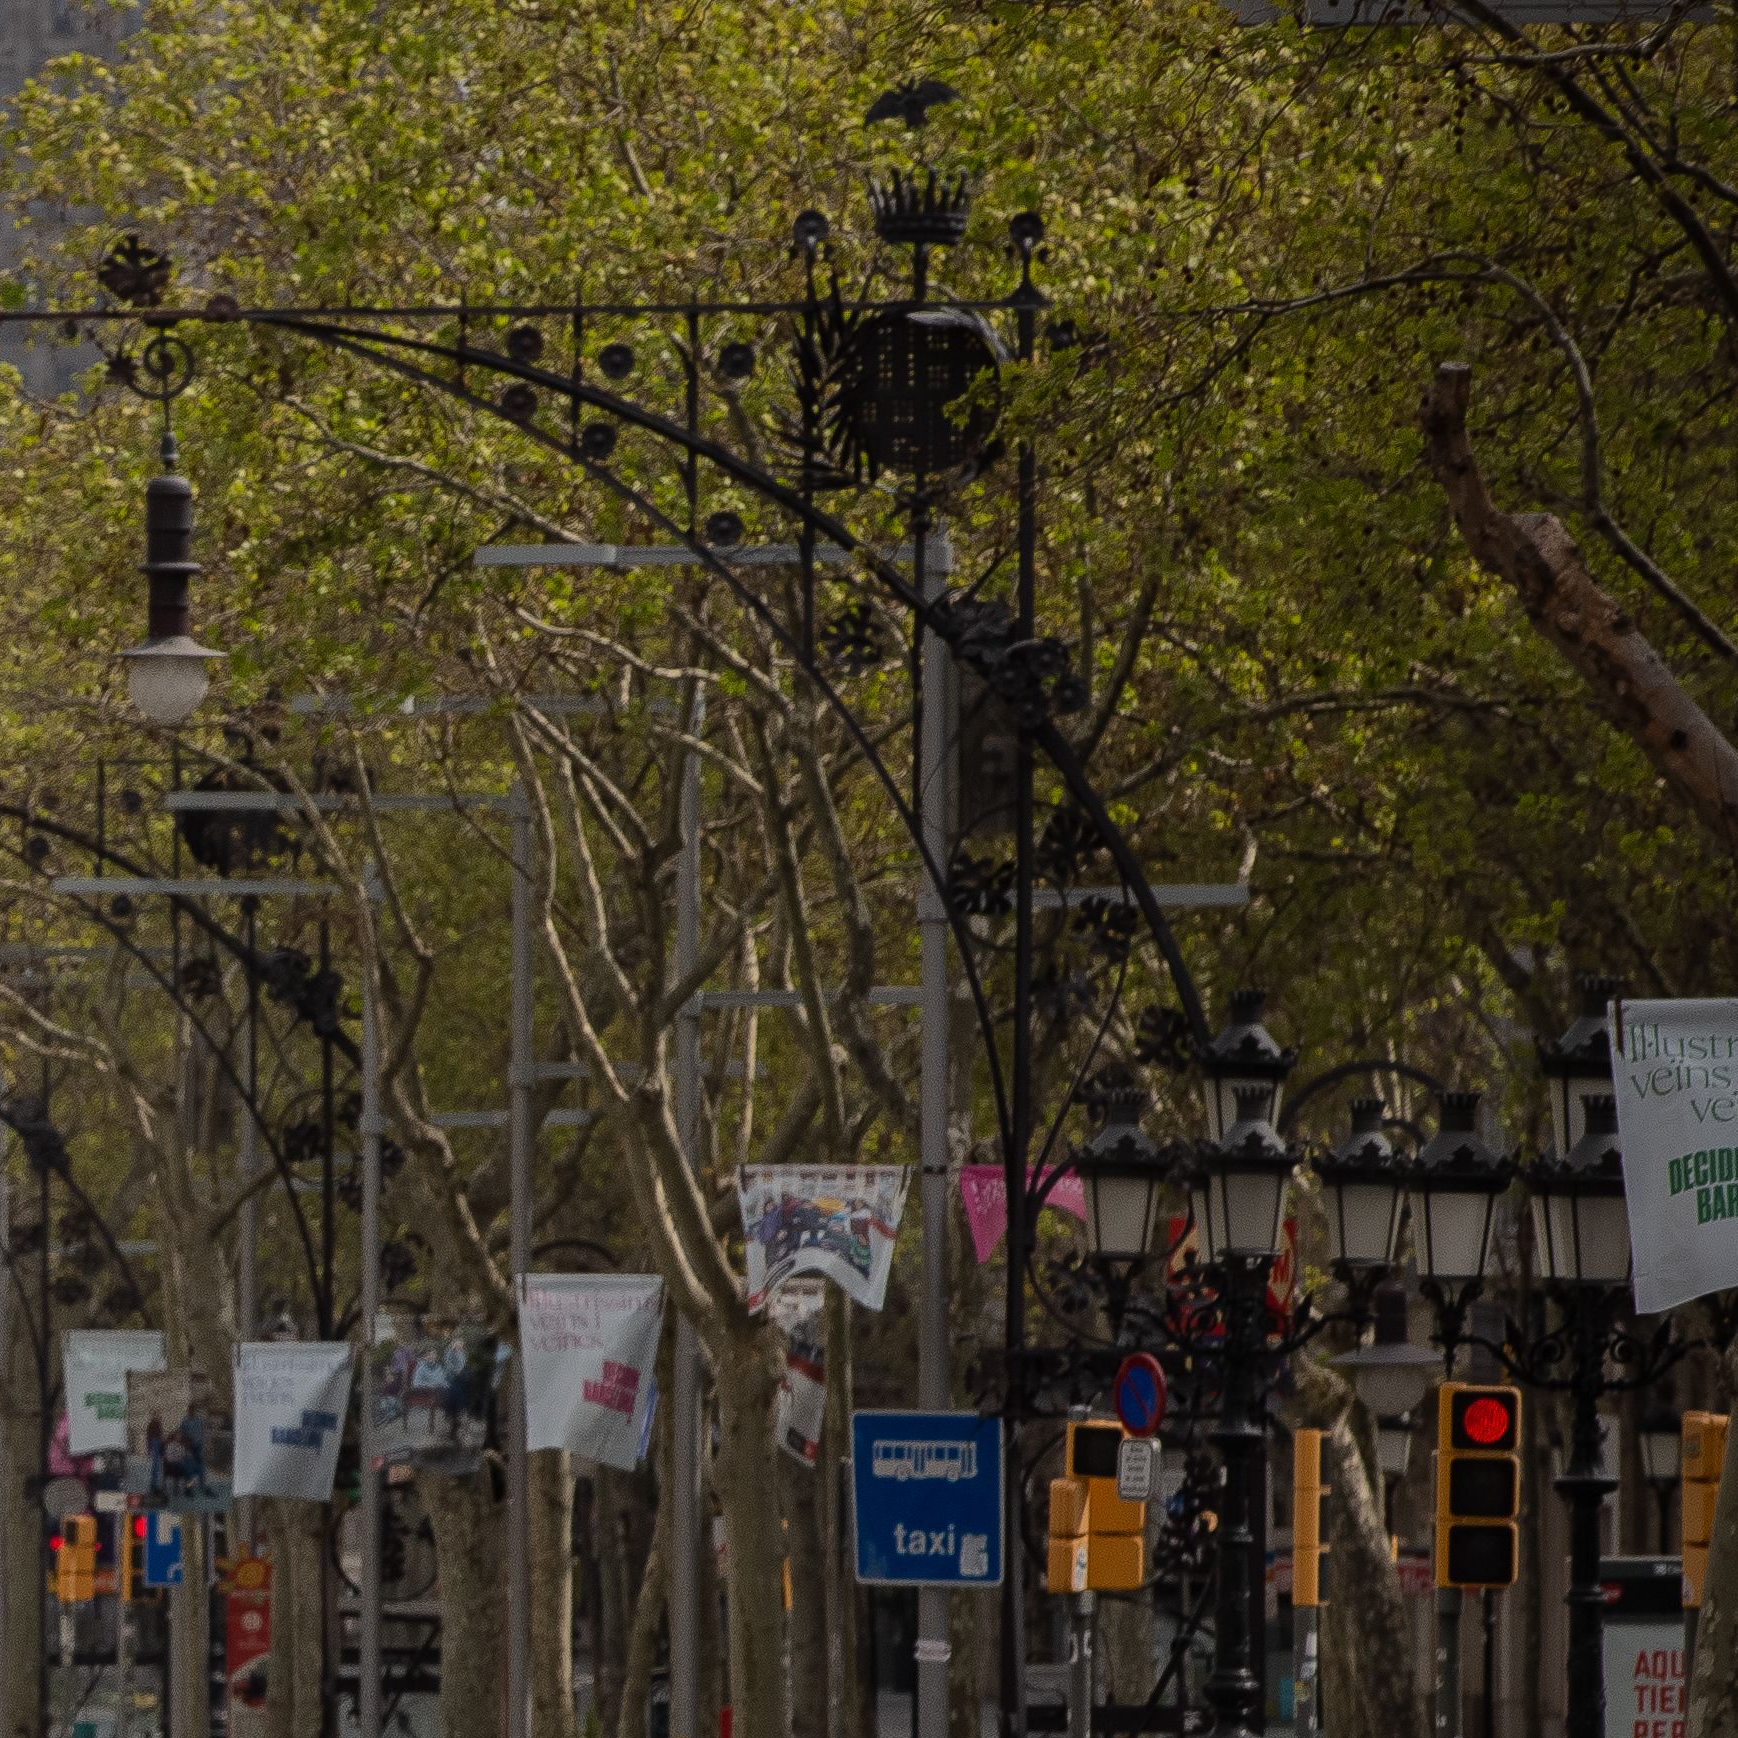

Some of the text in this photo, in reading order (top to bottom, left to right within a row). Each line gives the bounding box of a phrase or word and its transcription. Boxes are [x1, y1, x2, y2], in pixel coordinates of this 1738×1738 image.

[1630, 1059, 1732, 1099] veïns
[1690, 1091, 1738, 1123] ve
[893, 1523, 956, 1557] taxi
